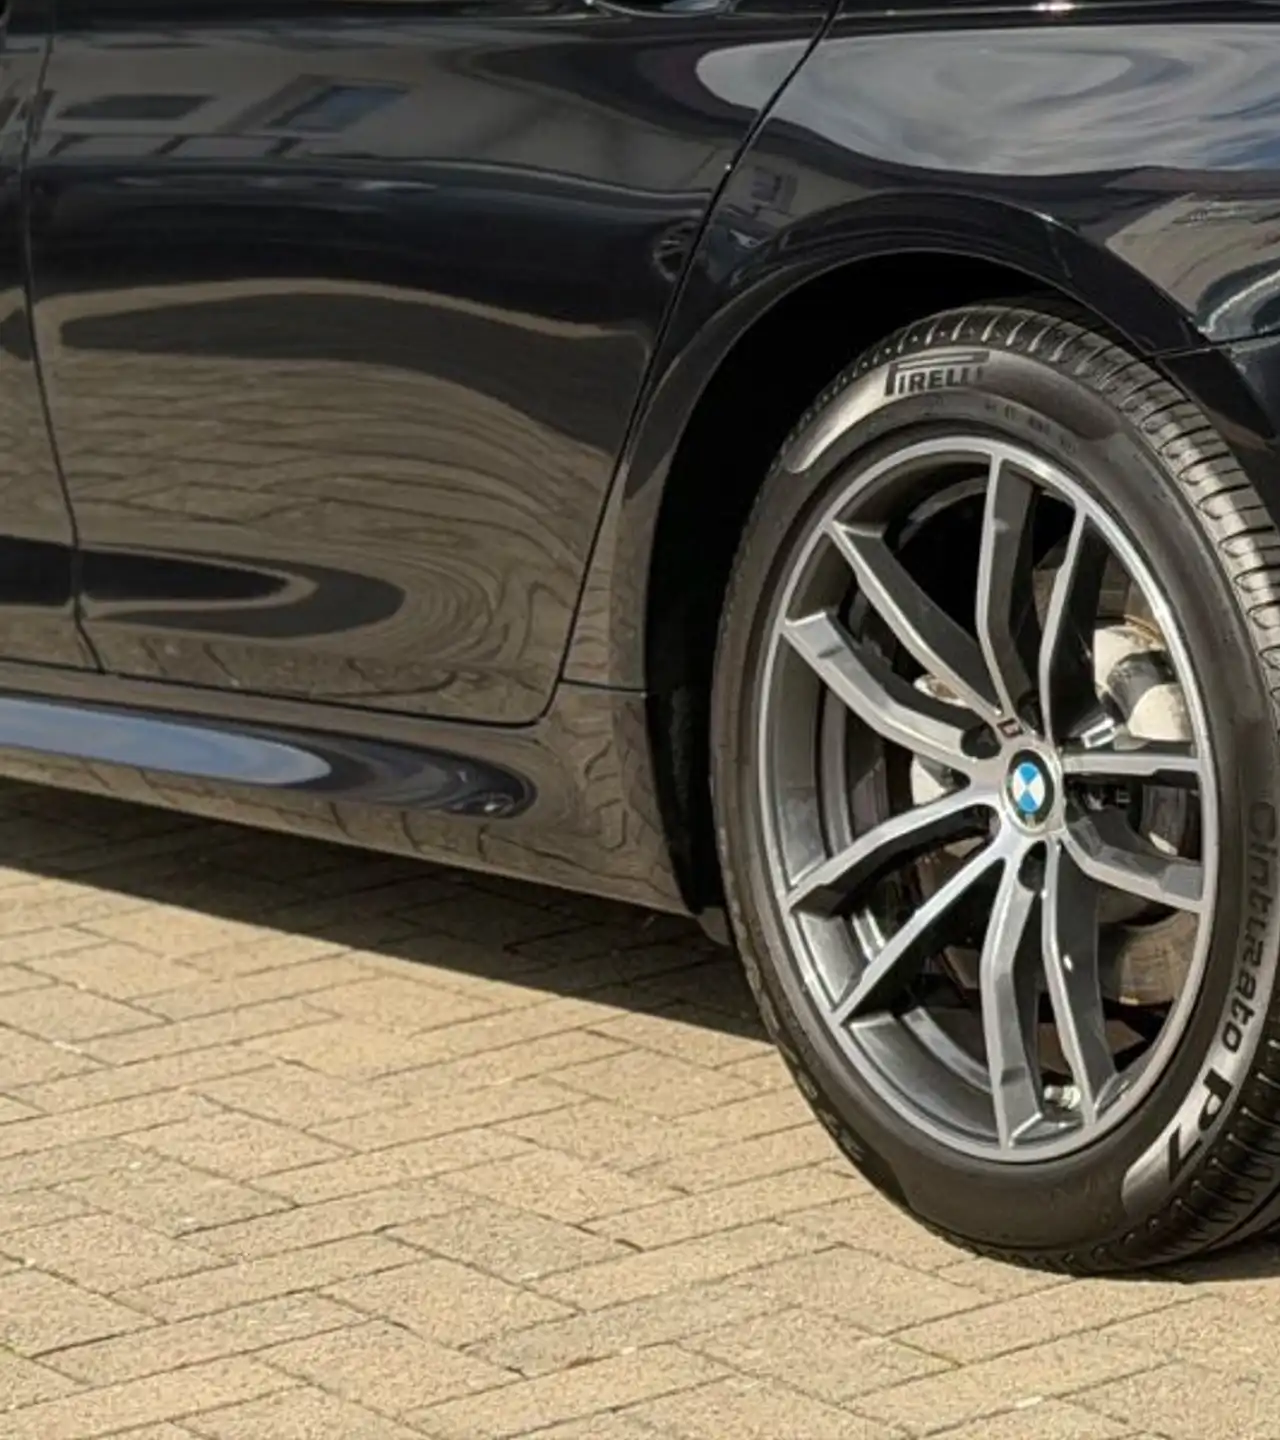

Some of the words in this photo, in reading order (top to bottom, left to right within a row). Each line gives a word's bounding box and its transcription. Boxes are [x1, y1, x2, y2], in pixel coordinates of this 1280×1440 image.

[884, 351, 991, 397] PIRELLI
[1221, 801, 1279, 1054] Cinturato
[1168, 1067, 1234, 1184] P7
